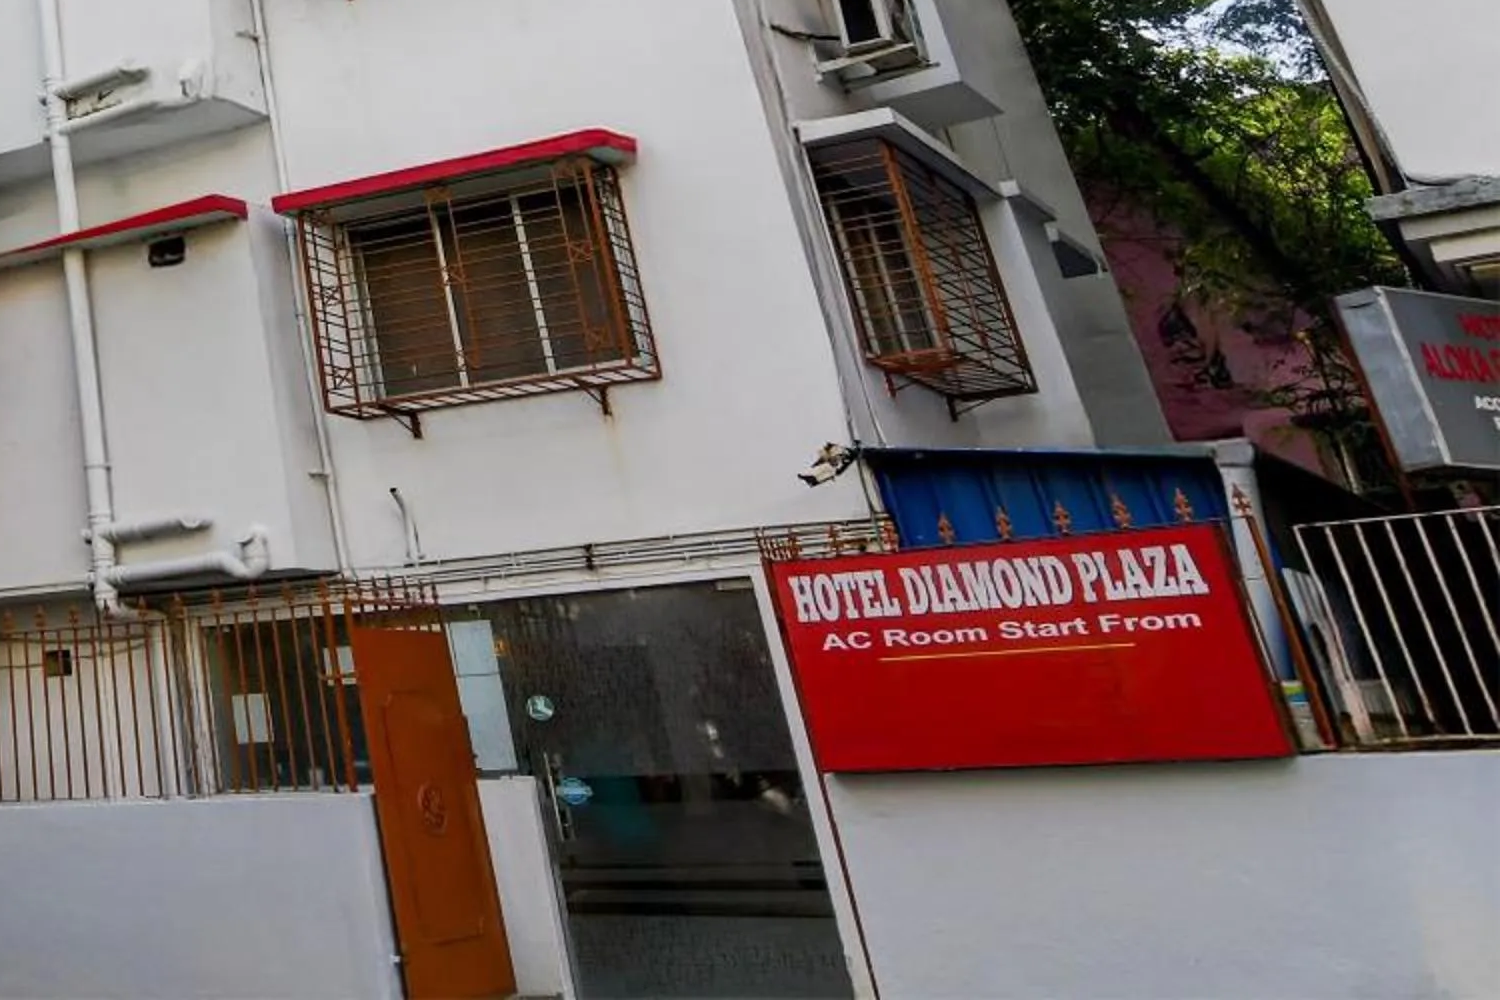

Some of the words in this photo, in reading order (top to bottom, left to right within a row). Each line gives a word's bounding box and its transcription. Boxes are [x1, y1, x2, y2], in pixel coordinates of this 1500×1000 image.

[788, 569, 902, 623] HOTEL
[898, 555, 1073, 615] DIAMOND
[1071, 543, 1210, 603] PLAZA
[822, 631, 872, 651] AC
[883, 626, 989, 648] Room
[998, 616, 1090, 640] Start
[1098, 612, 1202, 634] From
